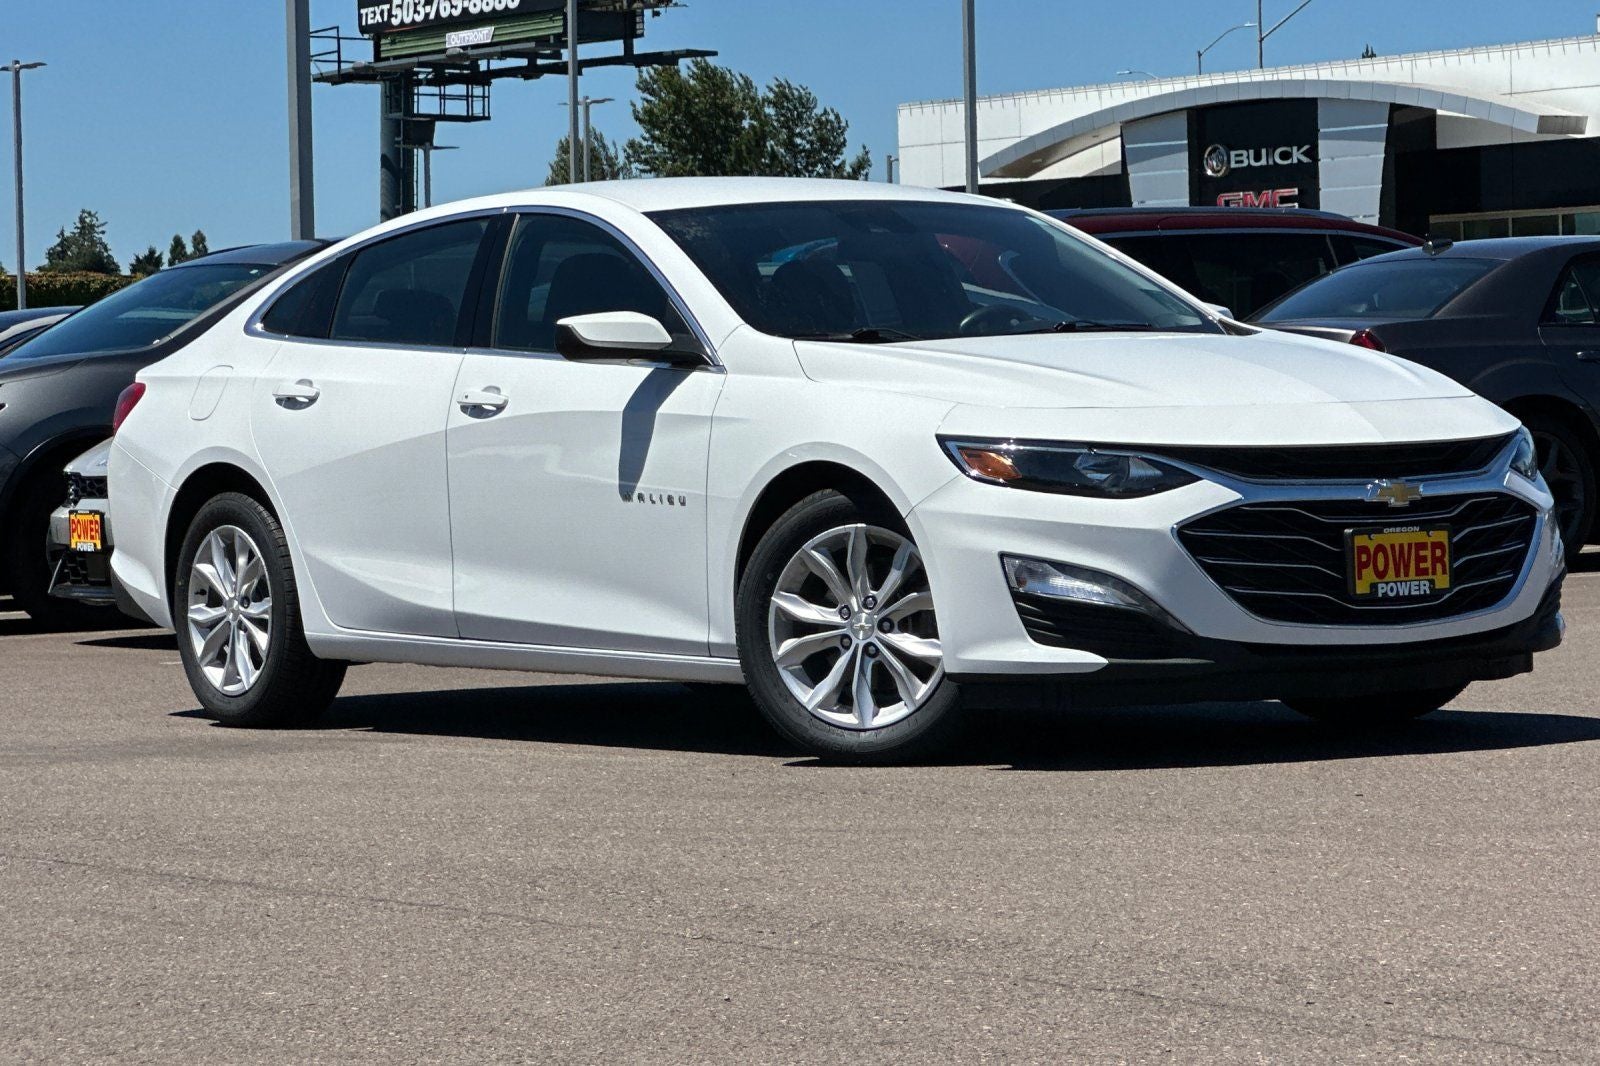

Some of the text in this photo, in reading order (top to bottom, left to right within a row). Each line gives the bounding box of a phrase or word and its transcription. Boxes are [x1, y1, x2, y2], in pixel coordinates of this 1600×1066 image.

[360, 4, 391, 26] TEXT
[450, 30, 489, 45] OUTFRONT
[1229, 144, 1313, 169] BUICK
[1216, 187, 1299, 209] GMC
[71, 518, 100, 541] POWER
[1383, 525, 1420, 534] OREGON
[76, 542, 95, 552] POWER
[1356, 540, 1449, 581] POWER
[1377, 580, 1431, 598] POWER
